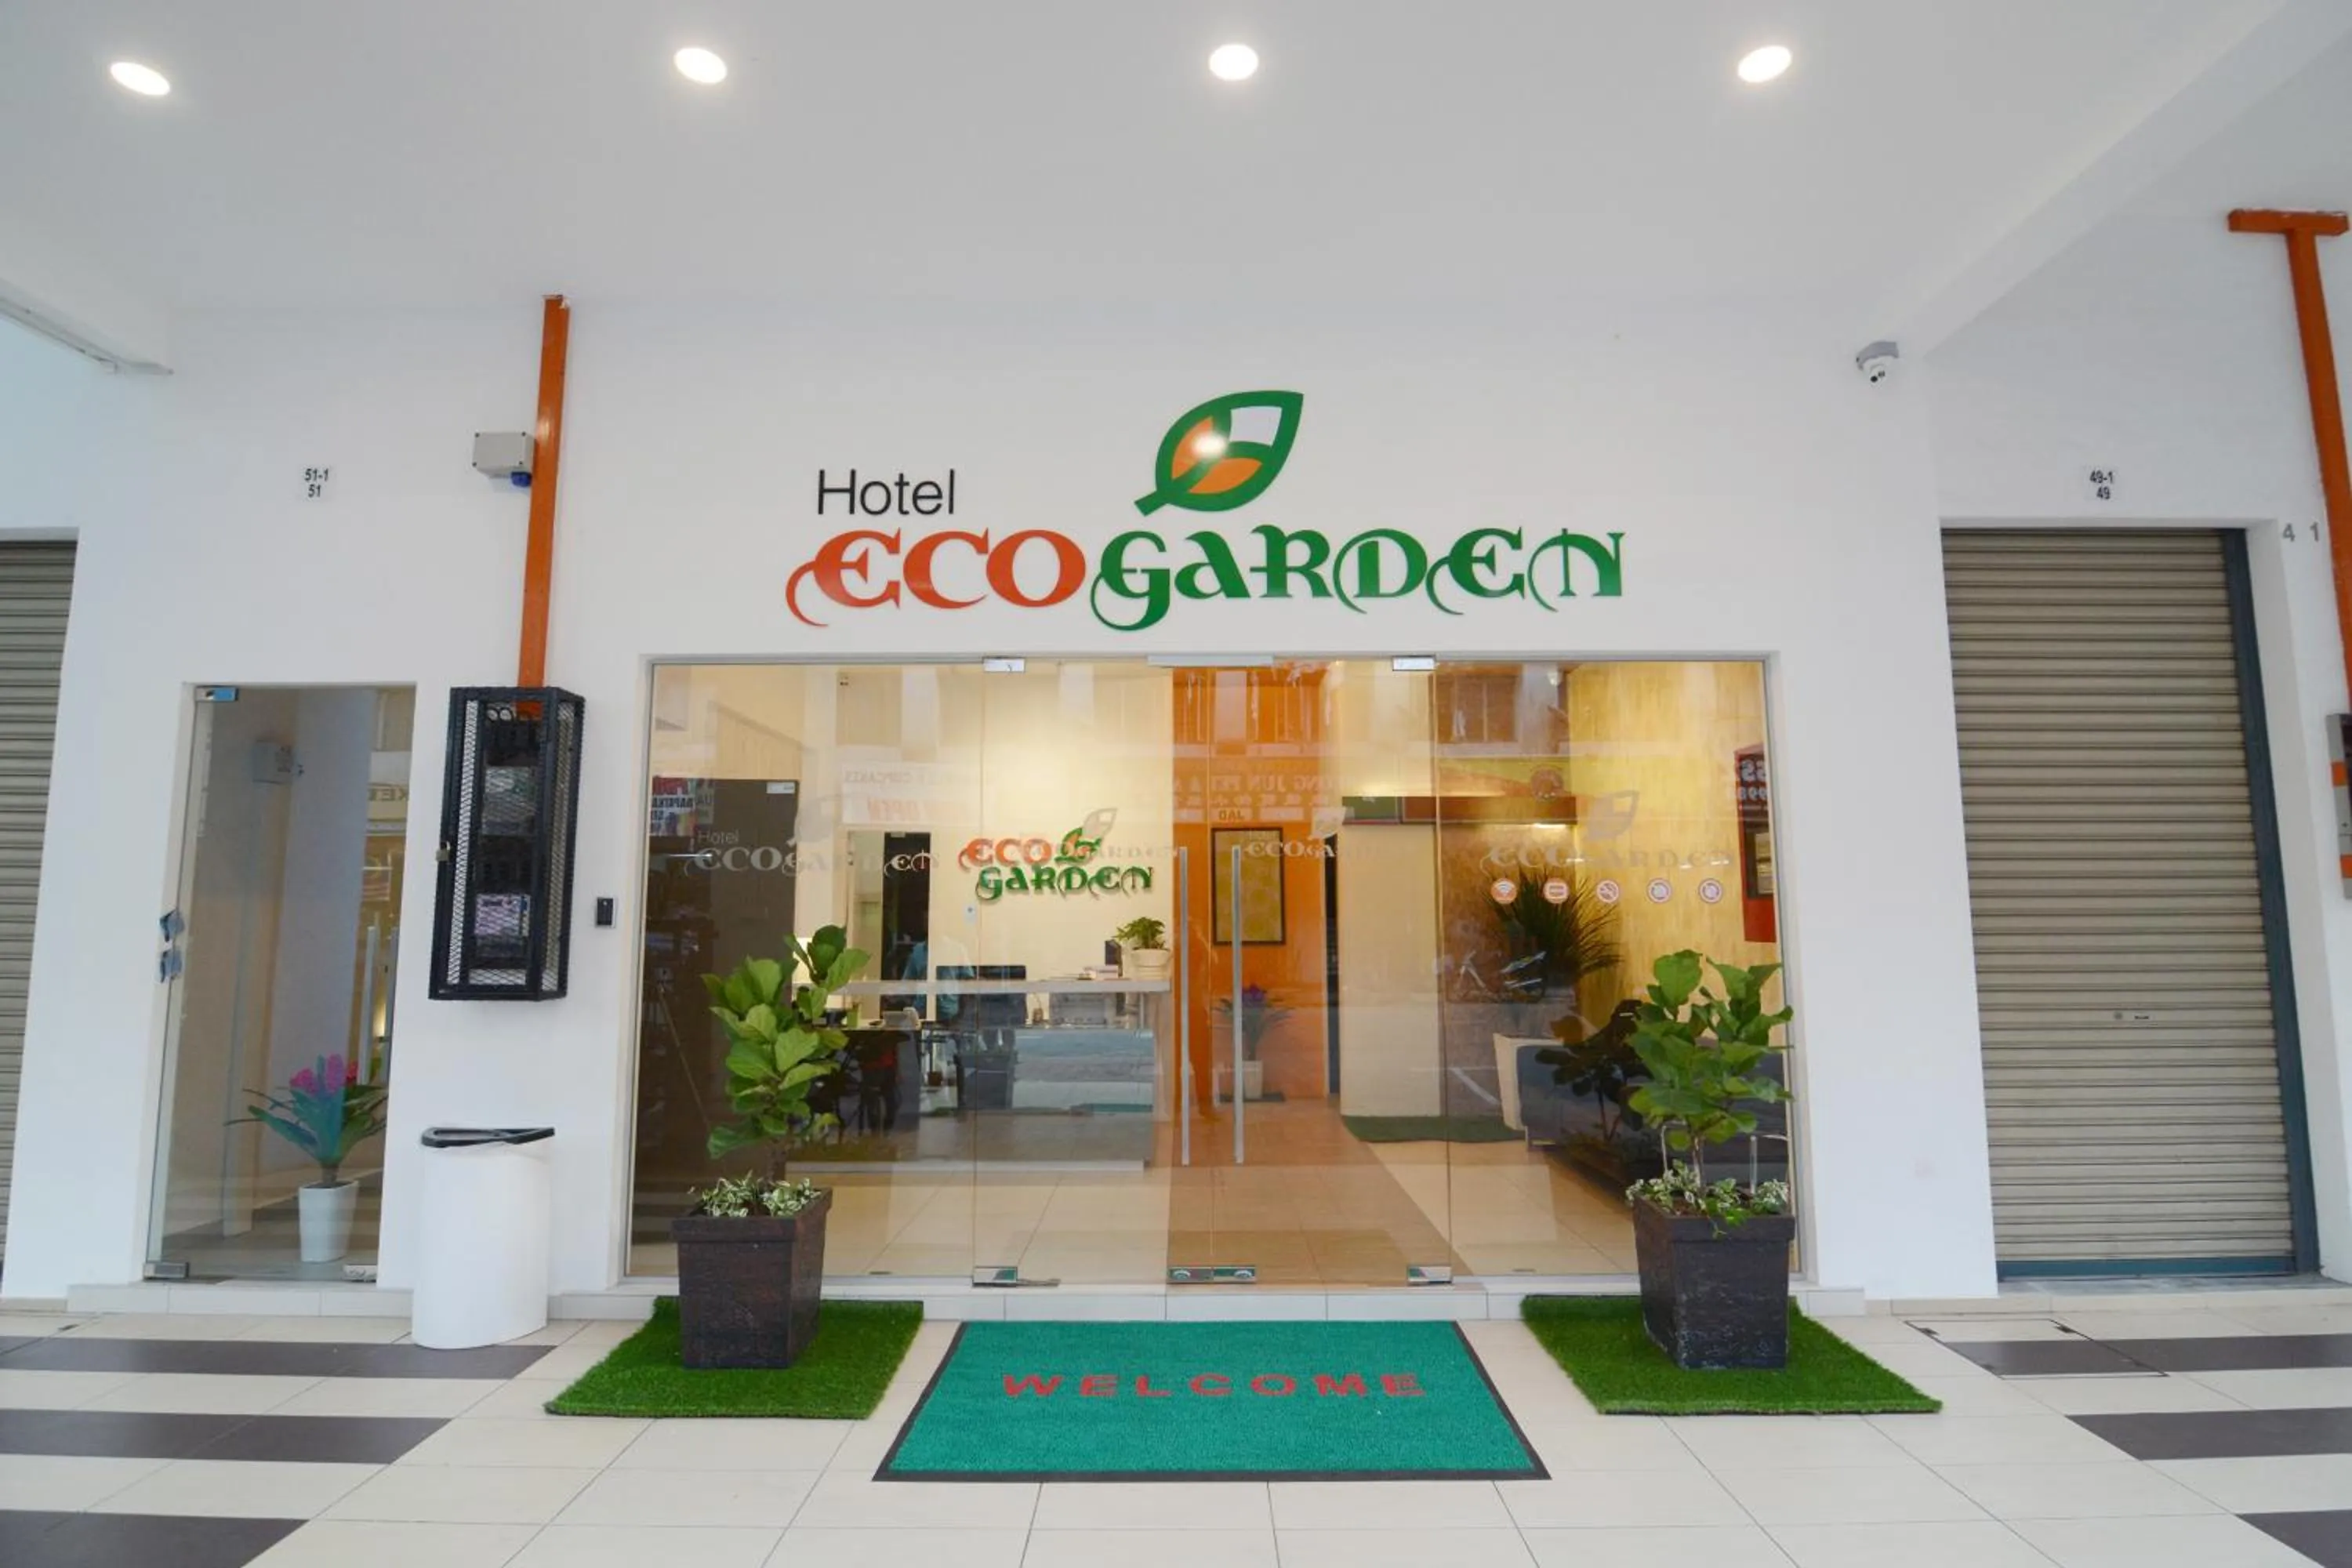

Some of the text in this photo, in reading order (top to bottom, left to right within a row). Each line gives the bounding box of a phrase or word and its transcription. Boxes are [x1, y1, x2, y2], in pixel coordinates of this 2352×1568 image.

[304, 468, 329, 482] 51-1
[2089, 470, 2114, 484] 49-1
[308, 484, 321, 498] 51
[817, 468, 956, 517] Hotel
[2096, 486, 2111, 500] 49
[975, 866, 1153, 901] GARDEN
[1002, 1374, 1425, 1398] WELCOME
